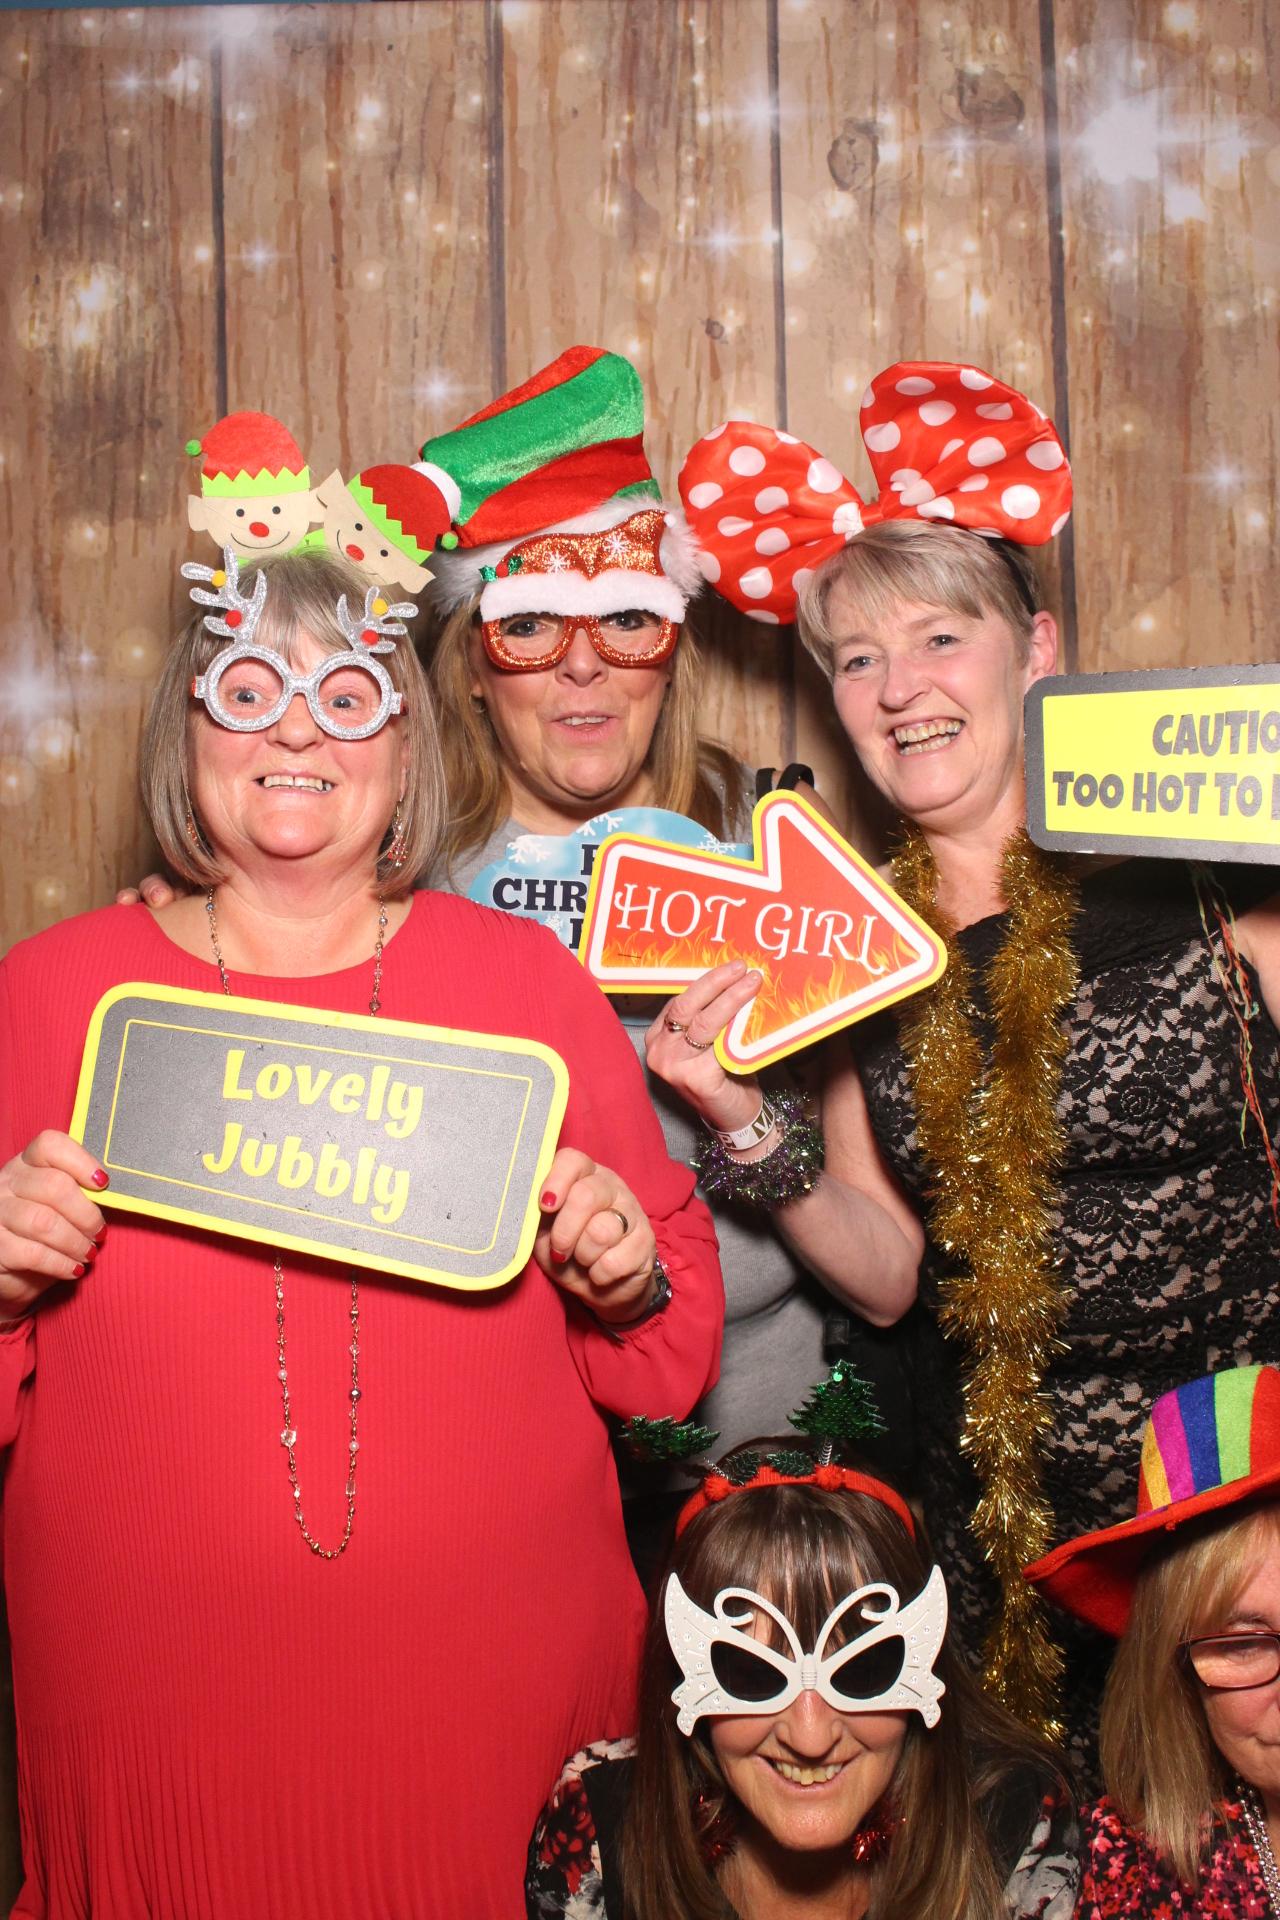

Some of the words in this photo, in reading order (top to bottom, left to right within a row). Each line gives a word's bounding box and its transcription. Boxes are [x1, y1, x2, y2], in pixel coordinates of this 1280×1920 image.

[1053, 771, 1124, 809] TOO
[1132, 772, 1206, 814] HOT
[1214, 772, 1262, 818] TO
[614, 883, 747, 943] HOT
[754, 903, 885, 975] GIRL
[222, 1049, 424, 1139] Lovely
[203, 1122, 411, 1224] Jubbly
